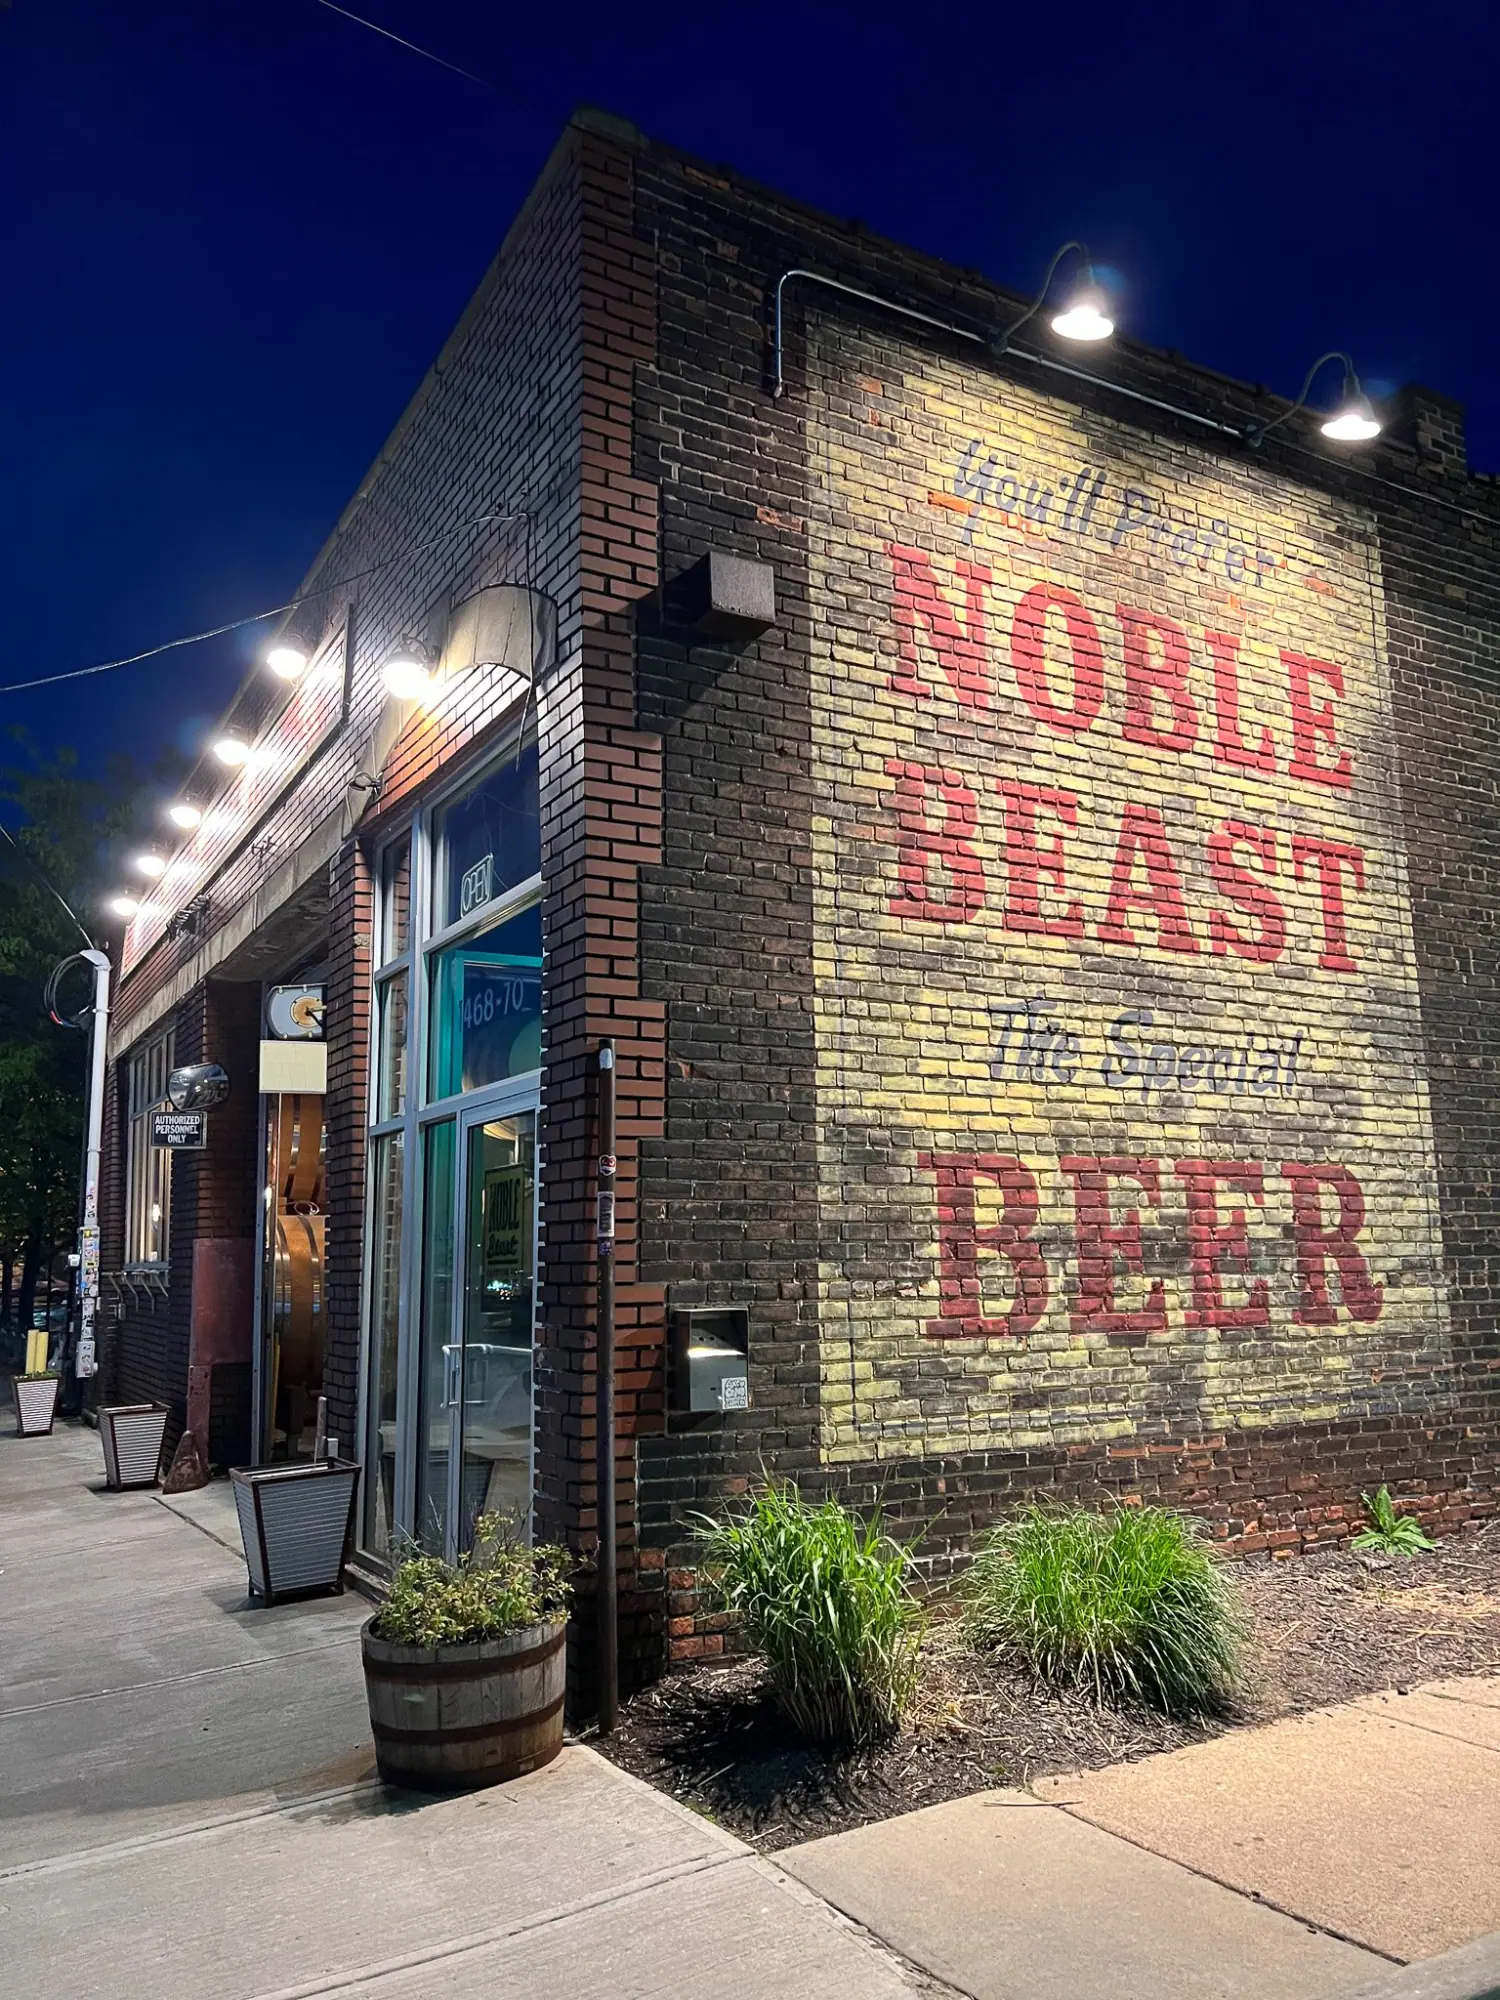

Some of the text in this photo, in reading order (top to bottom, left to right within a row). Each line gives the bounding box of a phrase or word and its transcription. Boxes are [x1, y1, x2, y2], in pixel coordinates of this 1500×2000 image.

[953, 438, 1108, 545] You'll
[883, 543, 1353, 788] NOBLE
[462, 859, 492, 912] OPEN
[884, 759, 1366, 973] BEAST
[988, 990, 1305, 1104] The Special
[154, 1115, 200, 1125] AUTHORIZED
[155, 1125, 199, 1134] PERSONNEL
[167, 1134, 187, 1144] ONLY
[917, 1151, 1384, 1338] BEER
